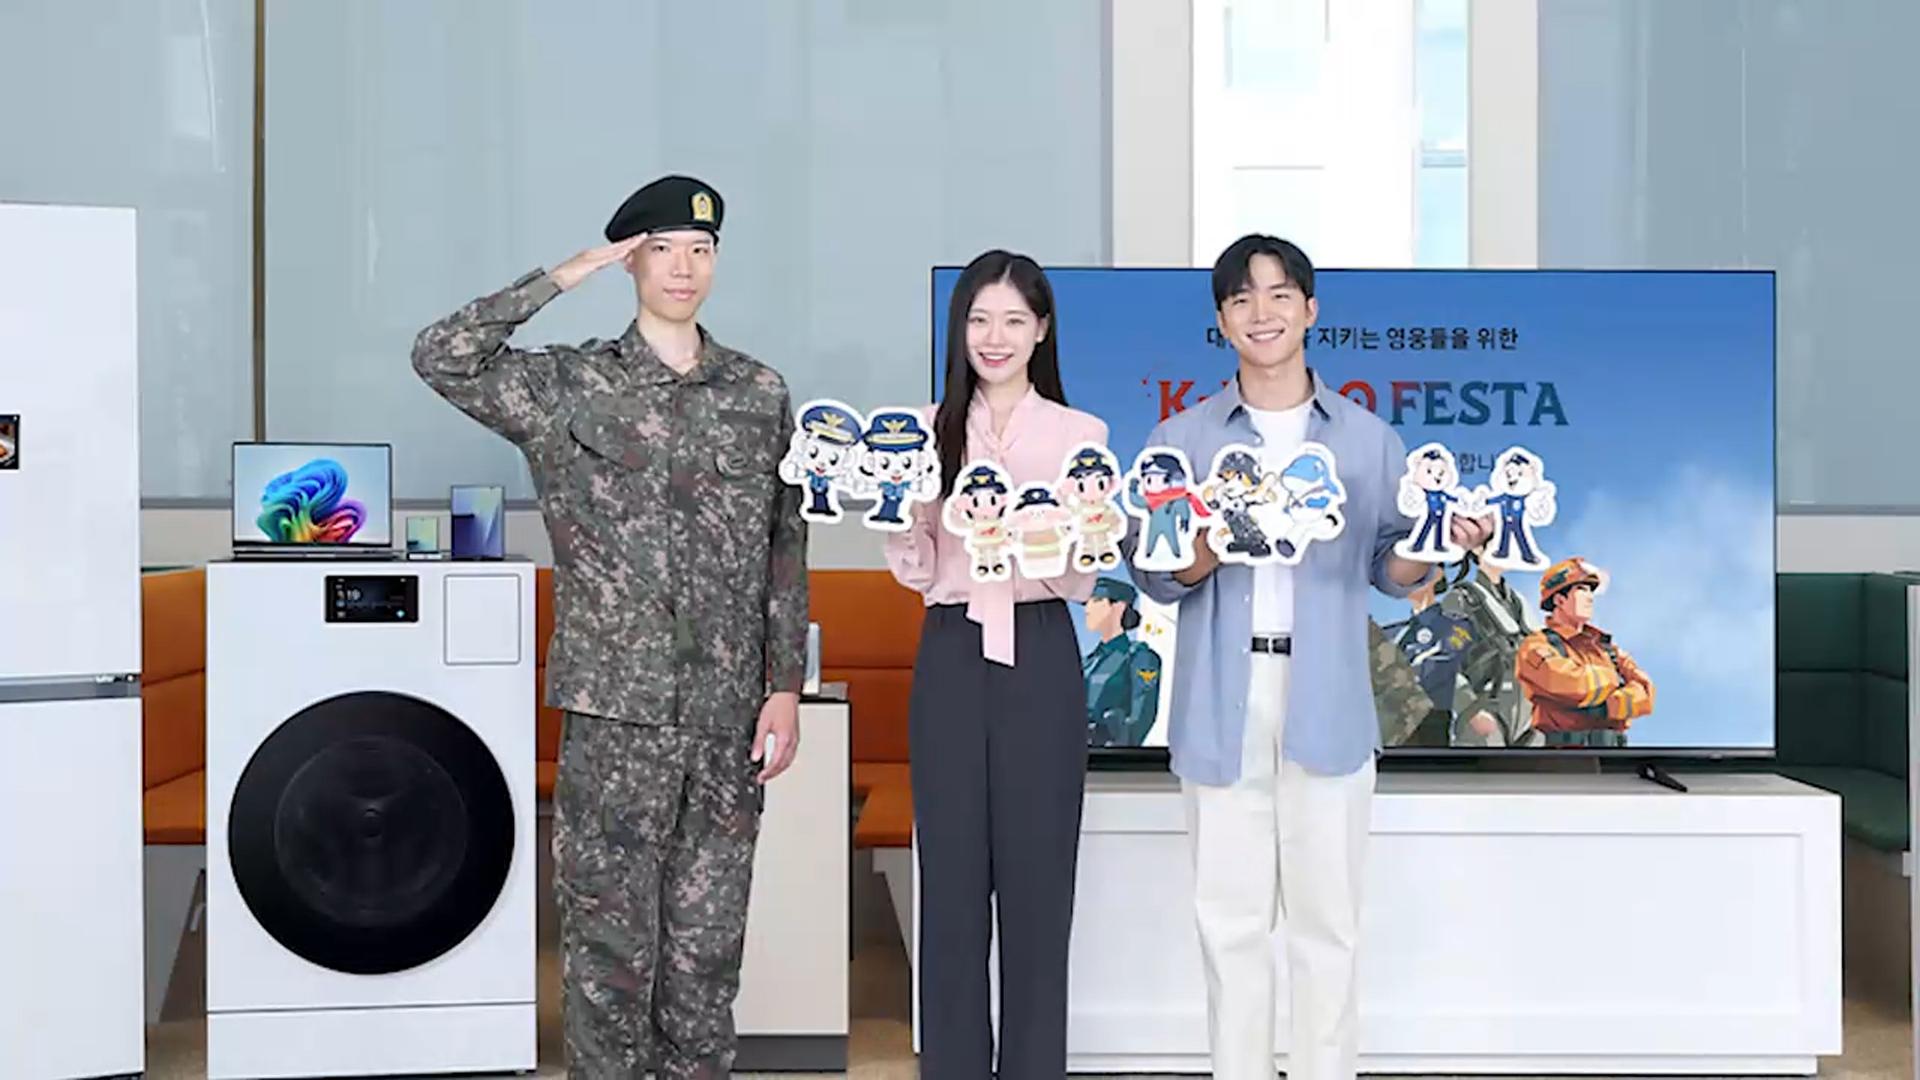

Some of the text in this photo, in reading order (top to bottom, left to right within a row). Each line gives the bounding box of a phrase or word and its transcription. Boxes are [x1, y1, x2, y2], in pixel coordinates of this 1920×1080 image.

[1317, 327, 1380, 350] 지키는
[1386, 327, 1470, 350] 영웅들을
[1477, 327, 1519, 350] 위한
[1389, 380, 1570, 426] FESTA
